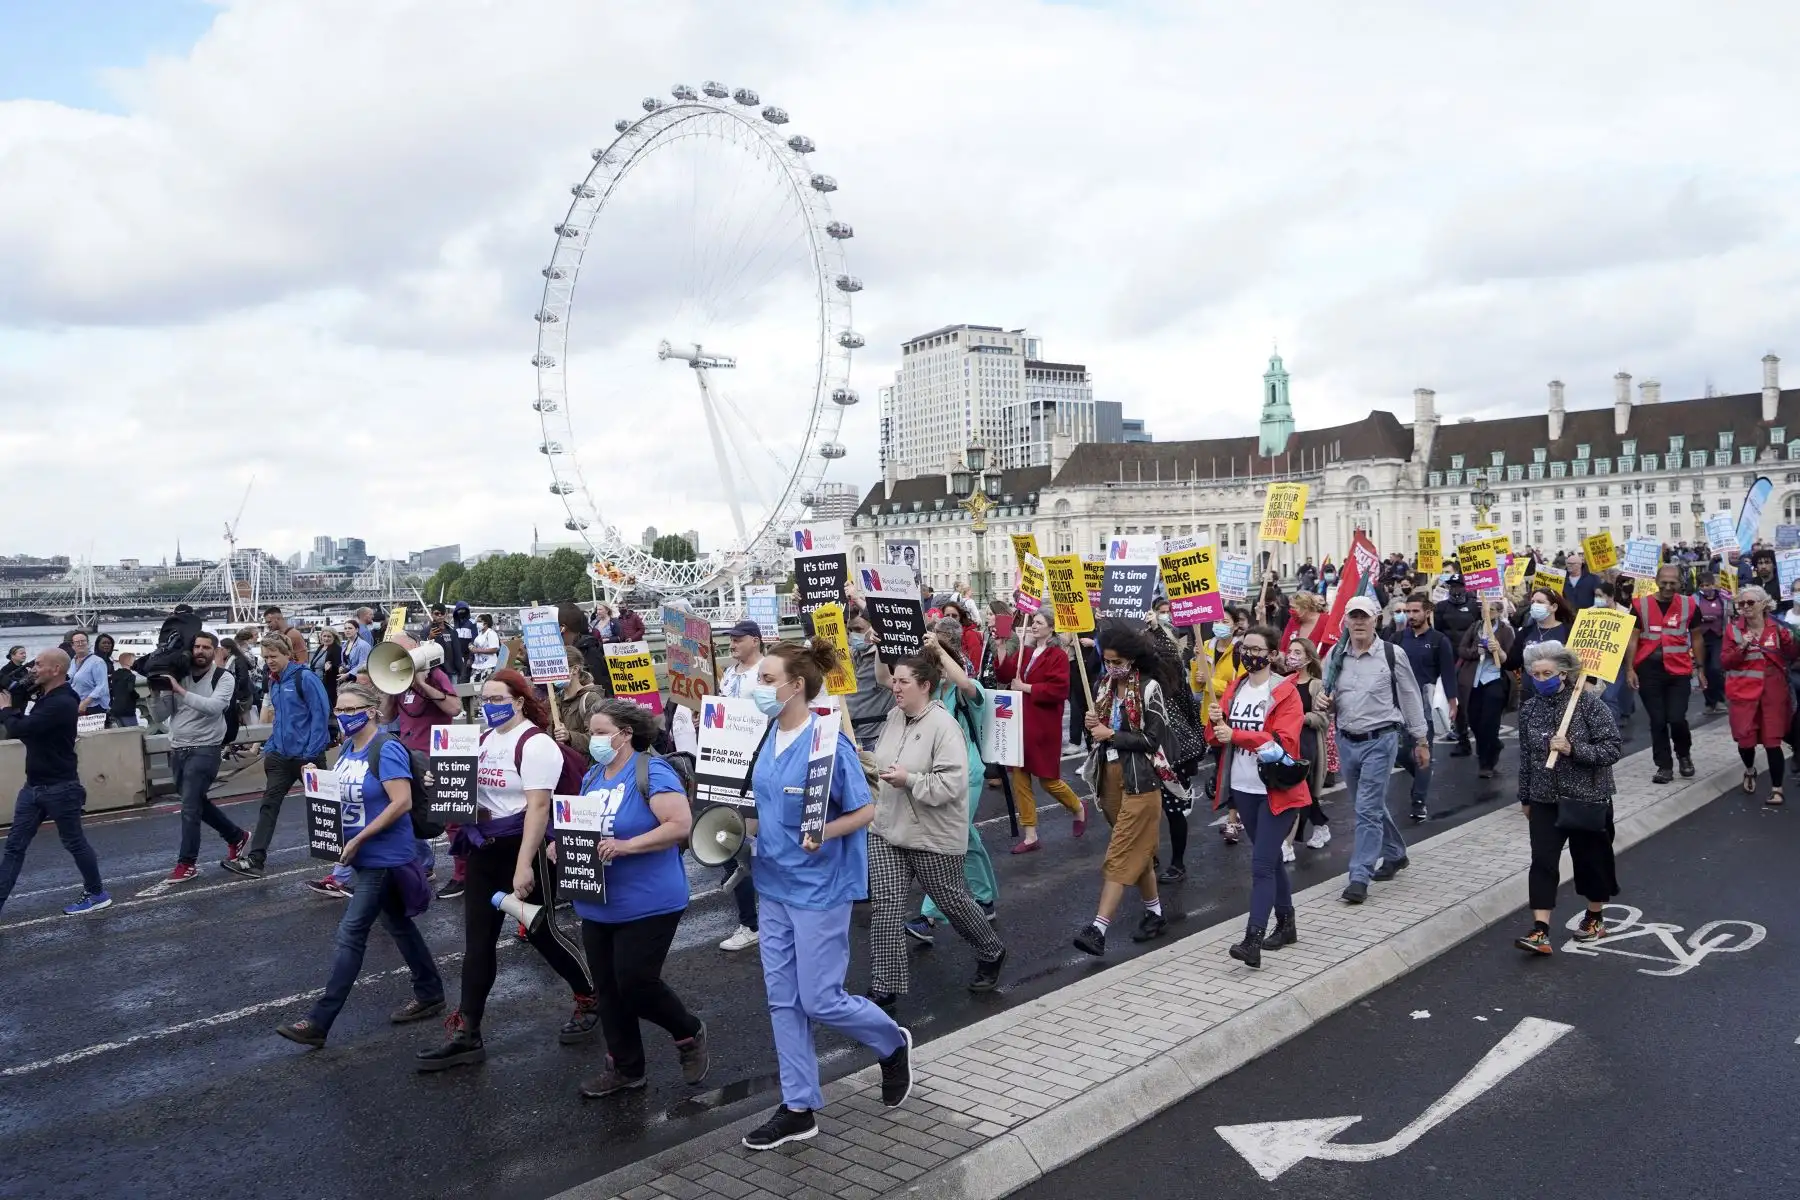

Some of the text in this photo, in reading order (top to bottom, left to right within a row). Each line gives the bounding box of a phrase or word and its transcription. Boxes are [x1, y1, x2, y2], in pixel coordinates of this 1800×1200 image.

[1271, 493, 1298, 501] PAY OUR
[1269, 502, 1292, 510] HEALTH
[1267, 511, 1299, 520] WORKERS
[1265, 519, 1288, 527] STRIKE
[1264, 527, 1287, 536] TO WIN
[1458, 542, 1491, 554] Migrants
[1161, 552, 1209, 571] Migrants
[1461, 555, 1477, 563] make
[803, 561, 838, 572] It's time
[1084, 563, 1104, 572] Migra
[1474, 560, 1491, 570] NHS
[1025, 564, 1044, 581] Migrants
[1049, 569, 1073, 580] PAY OUR
[1112, 570, 1147, 580] It's time
[1165, 571, 1190, 584] make
[1536, 572, 1562, 584] Migrants
[808, 576, 835, 586] to pay
[1023, 575, 1034, 586] make
[1051, 581, 1071, 591] HEALTH
[1030, 587, 1040, 597] NHS
[1114, 584, 1142, 594] to pay
[1169, 578, 1210, 596] our NHS
[807, 588, 839, 599] nursing
[1053, 592, 1083, 603] WORKERS
[1109, 596, 1142, 607] nursing
[1171, 602, 1182, 610] Stop
[876, 604, 913, 614] It's time
[1056, 604, 1076, 615] STRIKE
[1124, 609, 1146, 620] fairly
[1173, 605, 1213, 617] scapegoating
[883, 618, 911, 630] to pay
[1058, 615, 1079, 627] TO WIN
[1579, 620, 1621, 632] PAY OUR
[543, 624, 557, 634] OUR
[825, 622, 839, 636] OUR
[1575, 629, 1611, 640] HEALTH
[884, 632, 918, 645] nursing
[881, 645, 921, 655] staff fair
[1573, 639, 1620, 653] WORKERS
[1576, 648, 1603, 660] TRIKE
[547, 659, 563, 667] UNION
[609, 657, 649, 672] Migrants
[613, 671, 634, 680] make
[615, 680, 650, 692] our NHS
[669, 670, 709, 700] ZERO
[1233, 702, 1260, 717] LAC
[727, 713, 764, 726] Royal College
[733, 725, 755, 734] Nursing
[437, 761, 470, 771] It's time
[727, 758, 750, 766] NURSI
[817, 765, 828, 777] time
[451, 777, 466, 786] pay
[437, 789, 468, 800] nursing
[809, 785, 814, 796] to
[814, 785, 823, 797] pay
[312, 803, 321, 812] It's
[322, 804, 336, 814] time
[431, 802, 474, 814] staff fairly
[805, 800, 822, 814] nursing
[315, 816, 334, 828] to pay
[800, 817, 823, 832] staff fairly
[315, 829, 337, 841] nursing
[563, 836, 594, 847] It's time
[312, 841, 342, 854] staff fairly
[566, 851, 591, 863] to pay
[565, 865, 594, 878] nursing
[560, 879, 602, 893] staff fairly
